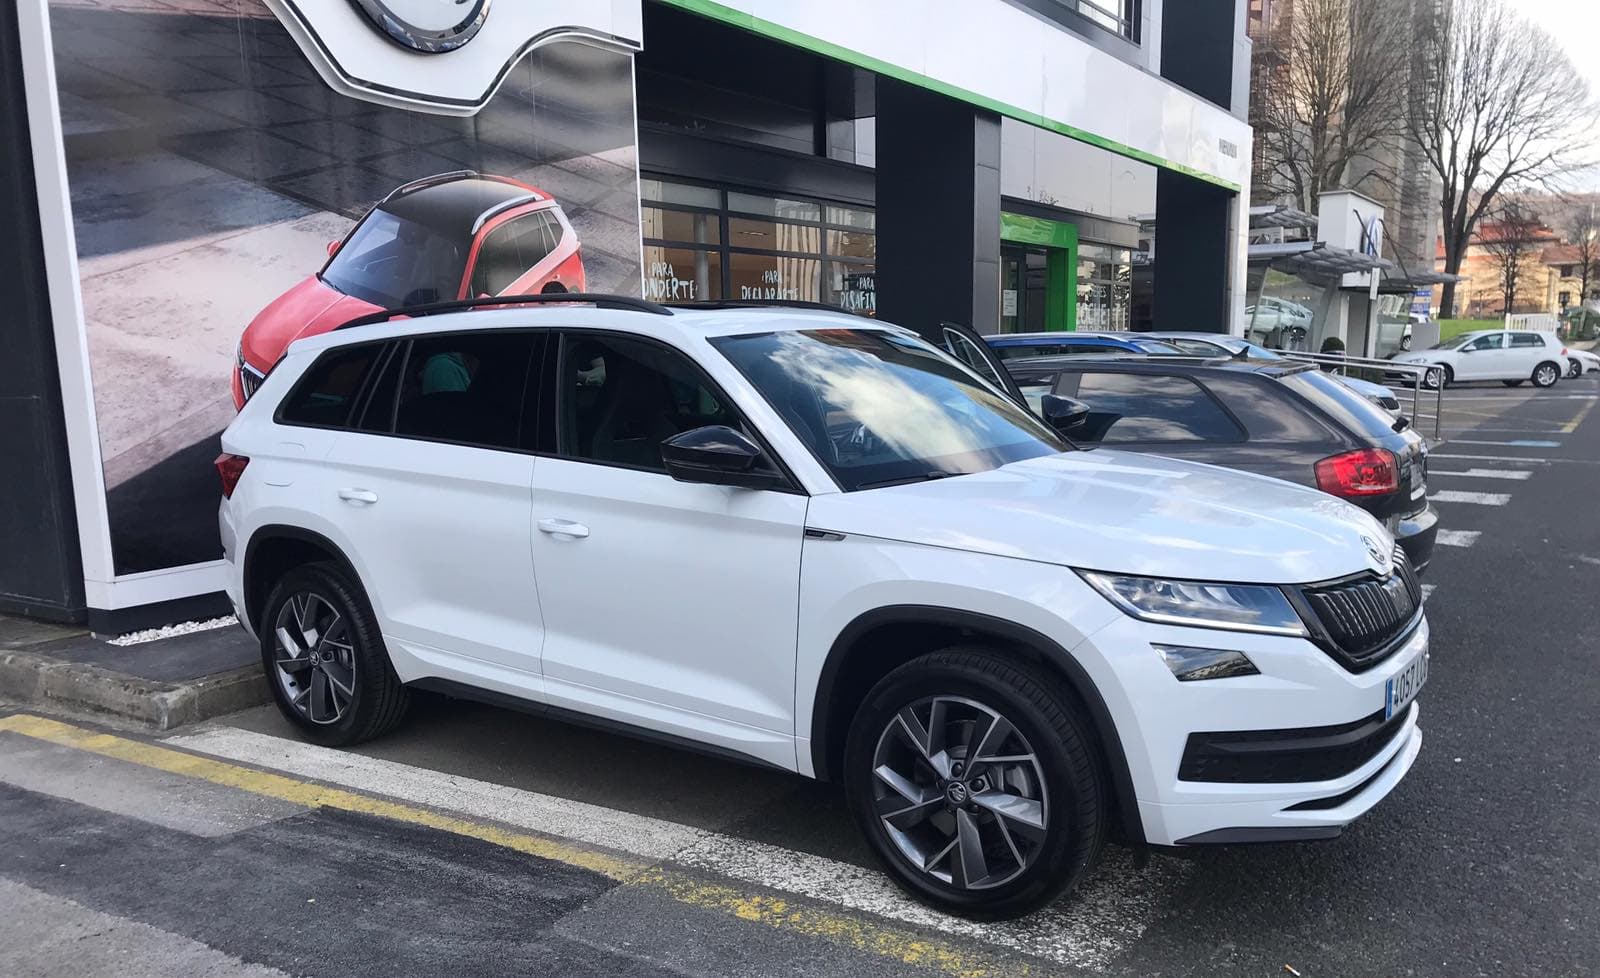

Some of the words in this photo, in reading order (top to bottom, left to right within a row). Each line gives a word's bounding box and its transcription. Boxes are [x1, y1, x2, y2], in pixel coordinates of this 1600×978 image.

[651, 262, 674, 278] PARA
[764, 270, 782, 284] PARA
[859, 276, 875, 290] PARA
[1394, 664, 1415, 708] 4057
